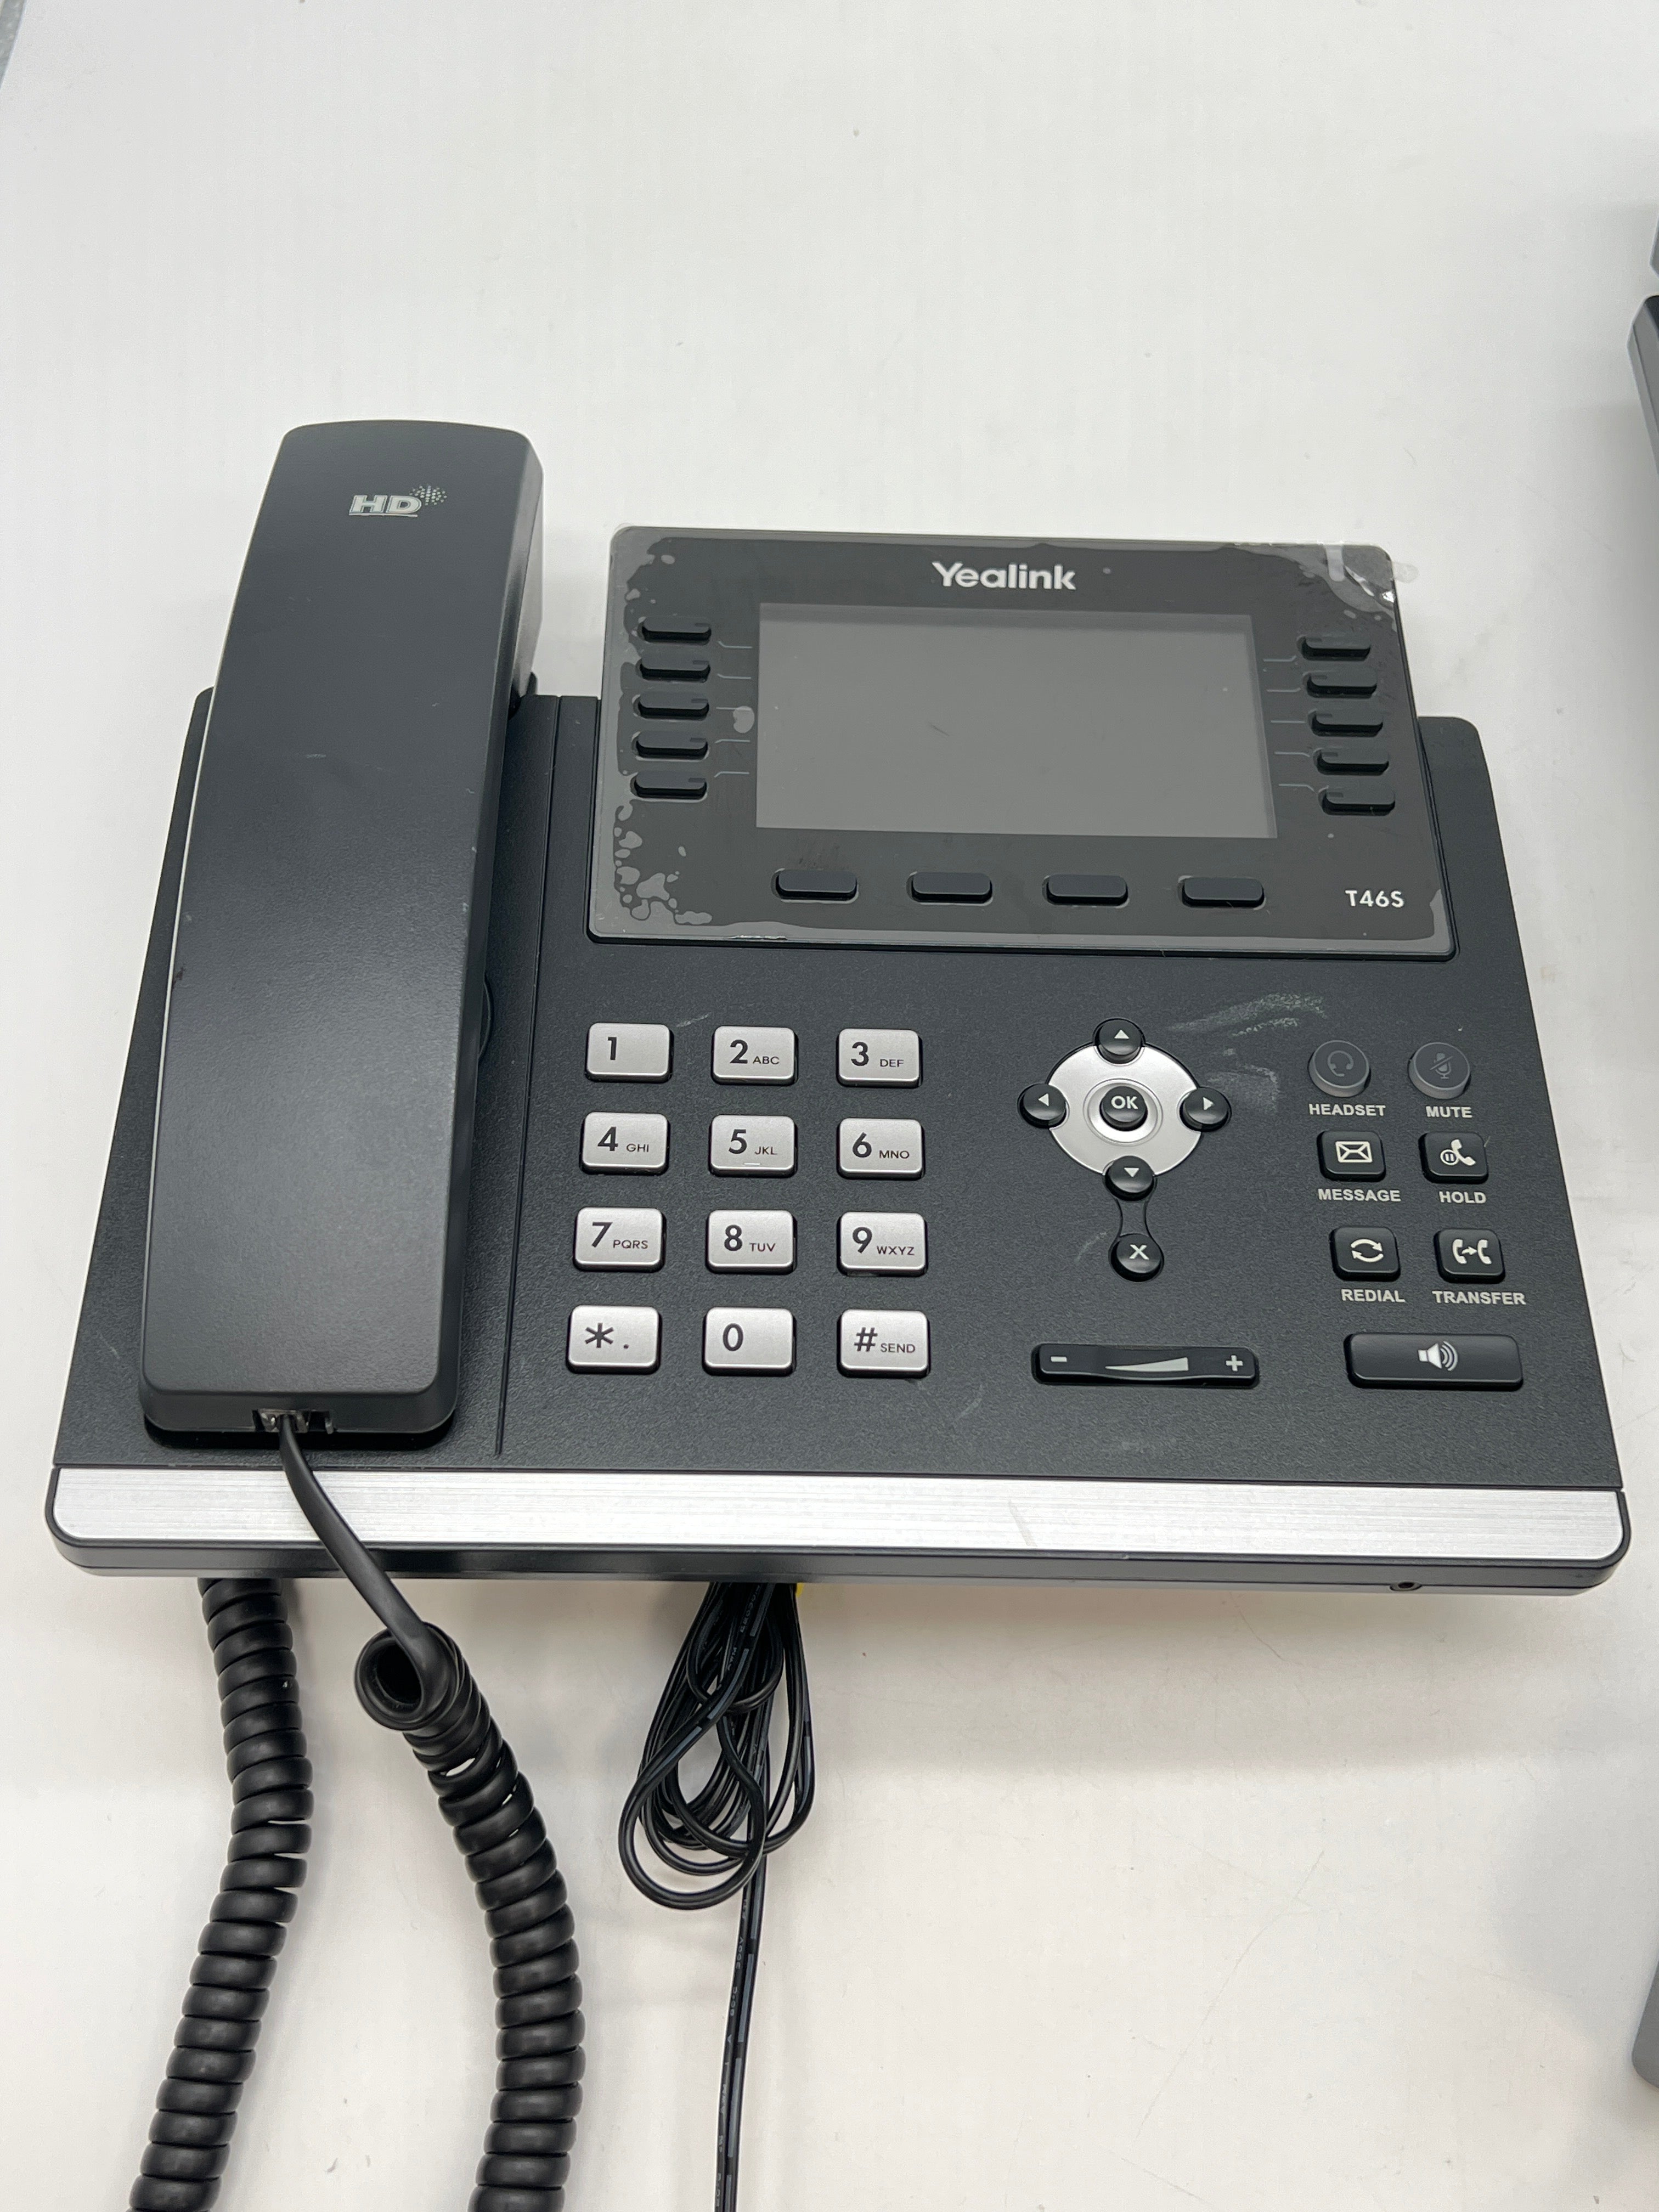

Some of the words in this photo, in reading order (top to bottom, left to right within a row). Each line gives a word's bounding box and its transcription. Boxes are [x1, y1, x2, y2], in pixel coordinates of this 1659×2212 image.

[349, 495, 422, 514] HD
[932, 562, 1076, 590] Yealink
[1345, 890, 1404, 908] T46S
[607, 1036, 617, 1060] 1
[729, 1039, 748, 1064] 2
[752, 1056, 780, 1065] ABC
[850, 1041, 870, 1066] 3
[879, 1059, 904, 1068] DEF
[1111, 1096, 1138, 1109] OK
[1308, 1103, 1386, 1116] HEADSET
[1425, 1105, 1473, 1118] MUTE
[597, 1126, 618, 1152] 4
[626, 1143, 649, 1153] GHI
[728, 1128, 747, 1154] 5
[754, 1146, 777, 1155] JKL
[852, 1132, 872, 1158] 6
[879, 1150, 910, 1159] MNO
[1318, 1188, 1401, 1202] MESSAGE
[1439, 1191, 1486, 1204] HOLD
[591, 1222, 613, 1248] 7
[613, 1239, 648, 1249] PQRS
[724, 1224, 743, 1251] 8
[749, 1243, 776, 1252] TUV
[852, 1227, 873, 1254] 9
[876, 1245, 915, 1256] WXYZ
[1341, 1289, 1406, 1302] REDIAL
[1431, 1290, 1527, 1305] TRANSFER
[723, 1323, 744, 1352] 0
[854, 1327, 878, 1352] #
[880, 1342, 916, 1354] SEND
